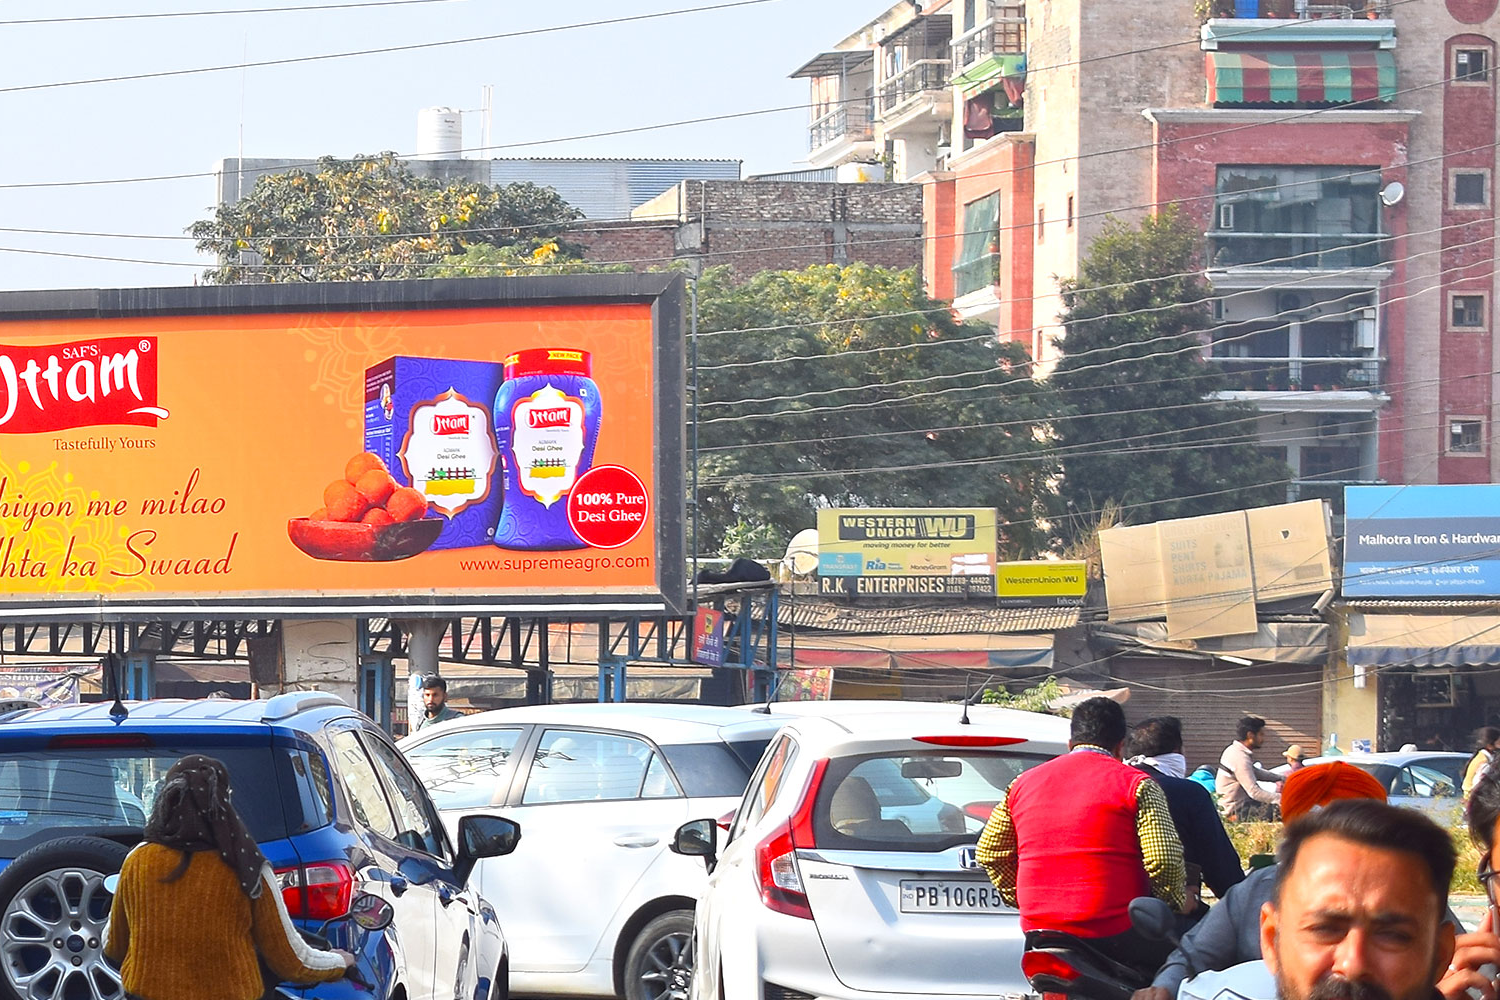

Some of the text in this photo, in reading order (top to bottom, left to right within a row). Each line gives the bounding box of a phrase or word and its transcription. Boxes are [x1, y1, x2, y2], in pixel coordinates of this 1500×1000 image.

[62, 344, 99, 359] SAF'S
[53, 436, 156, 452] Tastefully Yours
[87, 499, 128, 517] me
[141, 467, 227, 516] milao
[576, 492, 645, 506] 100% Pure
[578, 509, 642, 522] Desi Ghee
[843, 517, 968, 538] WESTERN WU
[865, 527, 916, 538] UNION
[1359, 534, 1411, 545] Malhotra
[1413, 534, 1437, 545] Iron
[1439, 533, 1450, 544] &
[61, 535, 97, 577] ka
[110, 529, 239, 576] Swaad
[460, 556, 650, 574] www.supremeagro.com
[866, 557, 887, 571] Ria
[821, 577, 848, 593] R.K.
[857, 577, 945, 593] ENTERPRISES
[915, 886, 1008, 908] PB10GR5
